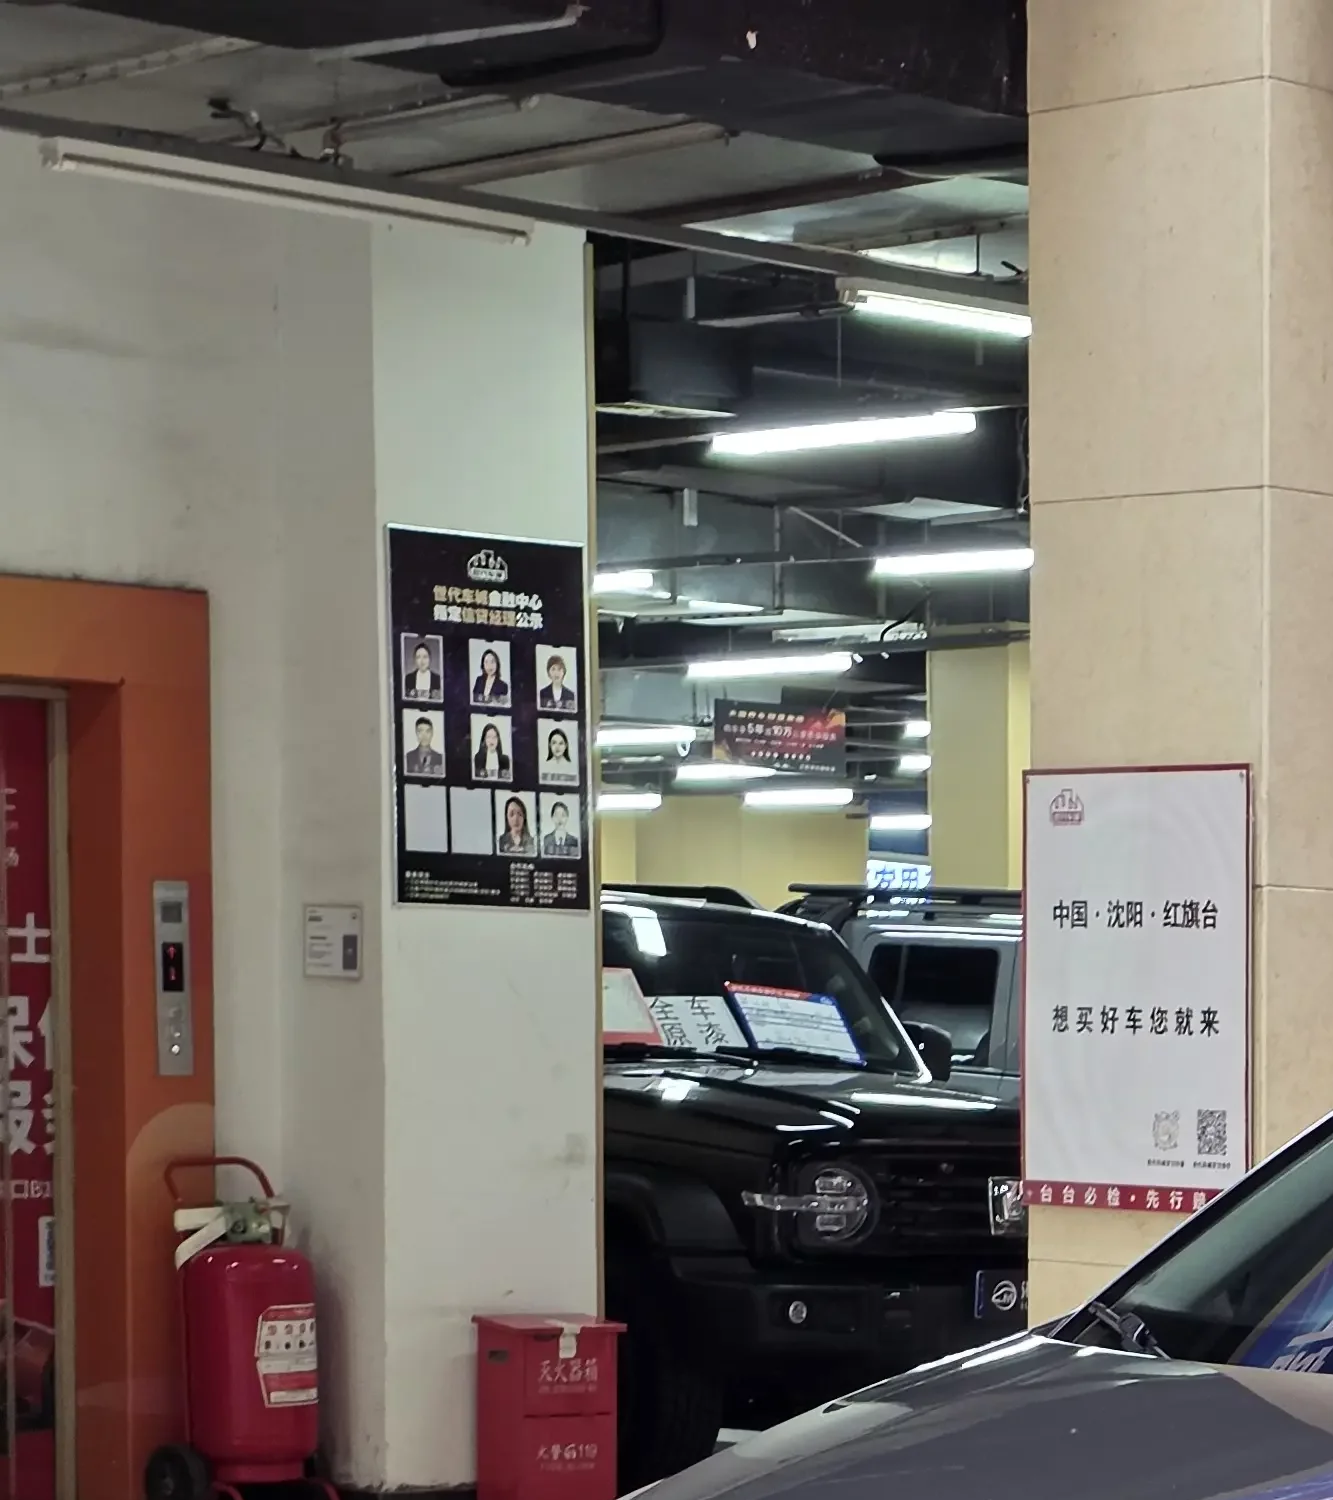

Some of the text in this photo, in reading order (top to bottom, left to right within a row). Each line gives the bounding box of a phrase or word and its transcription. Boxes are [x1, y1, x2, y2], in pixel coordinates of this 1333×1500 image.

[1052, 1003, 1220, 1038] 想买好车您就来
